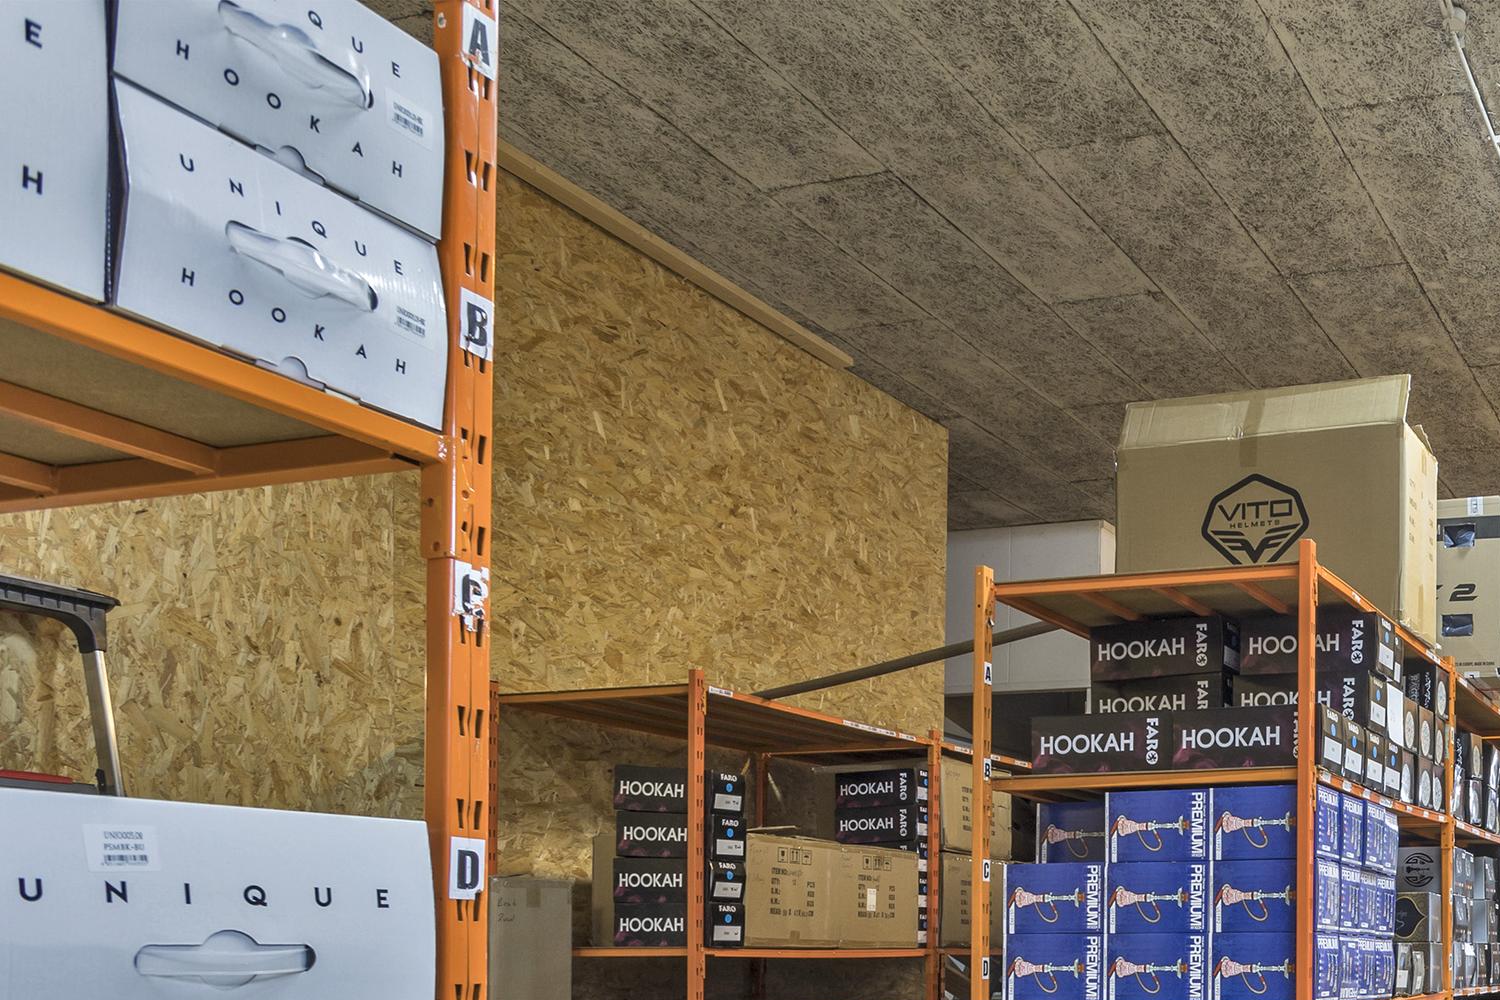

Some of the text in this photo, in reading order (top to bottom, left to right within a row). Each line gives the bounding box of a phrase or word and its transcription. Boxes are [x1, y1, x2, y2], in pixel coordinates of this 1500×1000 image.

[469, 18, 490, 66] A
[176, 40, 402, 178] HOOKAH
[180, 153, 402, 276] UNIQUE
[181, 267, 406, 375] HOOKAH
[467, 302, 488, 347] B
[1217, 500, 1293, 521] VITO
[1230, 519, 1280, 529] HELMETS
[1449, 583, 1477, 601] 2
[1098, 637, 1185, 662] HOOKAH
[1249, 633, 1340, 660] HOOAH
[985, 666, 991, 681] A
[1197, 680, 1208, 710] FAR
[1241, 691, 1331, 707] HOOKH
[1040, 732, 1134, 755] HOOKAH
[1182, 726, 1280, 749] HOOKAH
[720, 773, 738, 783] FARO
[984, 763, 991, 777] B
[620, 780, 684, 798] HOOKAH
[840, 781, 894, 797] HOOKAH
[900, 772, 908, 801] FARO
[624, 826, 688, 842] HOOKAH
[721, 818, 739, 828] FARO
[840, 817, 894, 832] HOOKAH
[900, 809, 908, 837] FARO
[1191, 792, 1203, 855] PREMIUM
[457, 849, 479, 891] D
[619, 873, 683, 888] HOOKAH
[984, 862, 989, 878] C
[18, 877, 390, 909] UNIQUE
[1086, 865, 1099, 927] PREMIUM
[1190, 865, 1202, 927] PREMIUM
[620, 917, 684, 932] HOOKAH
[983, 960, 989, 976] D
[1086, 936, 1098, 998] PREMIUM
[1189, 936, 1201, 998] PREMIUM
